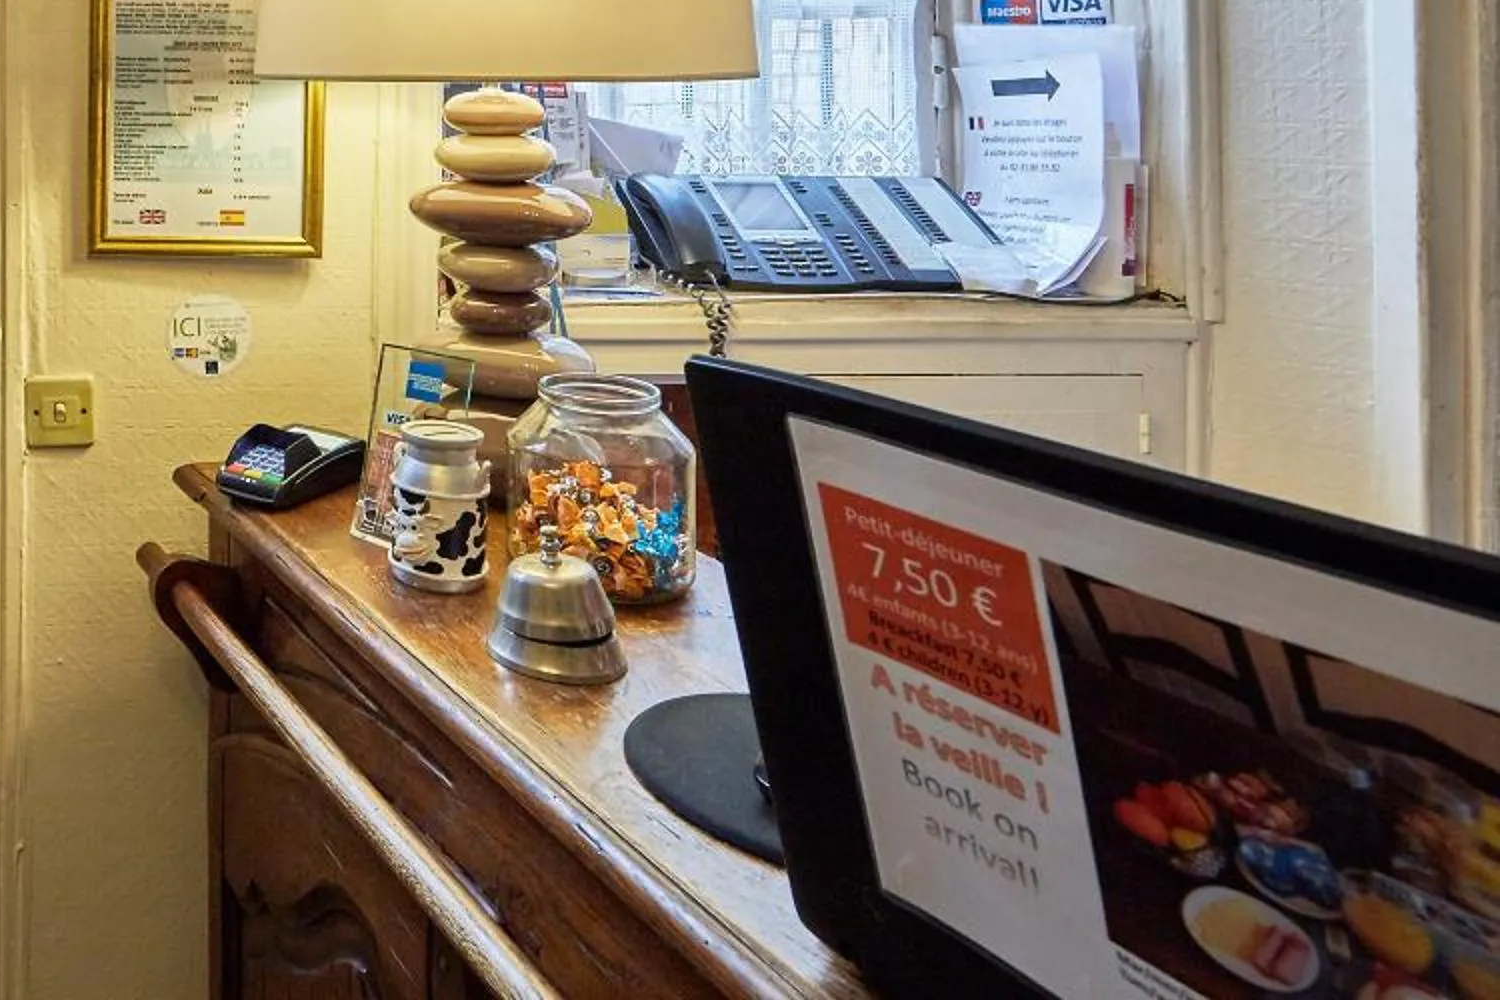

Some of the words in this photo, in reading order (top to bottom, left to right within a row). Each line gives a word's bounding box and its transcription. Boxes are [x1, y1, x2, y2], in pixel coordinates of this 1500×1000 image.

[173, 317, 201, 337] ICI
[843, 505, 1004, 578] Petit-déjeuner
[972, 585, 1003, 627] €
[871, 663, 897, 696] A
[902, 681, 1048, 767] réserver
[892, 711, 925, 749] la
[929, 734, 1027, 801] veille
[901, 757, 984, 822] Book
[994, 812, 1038, 851] on
